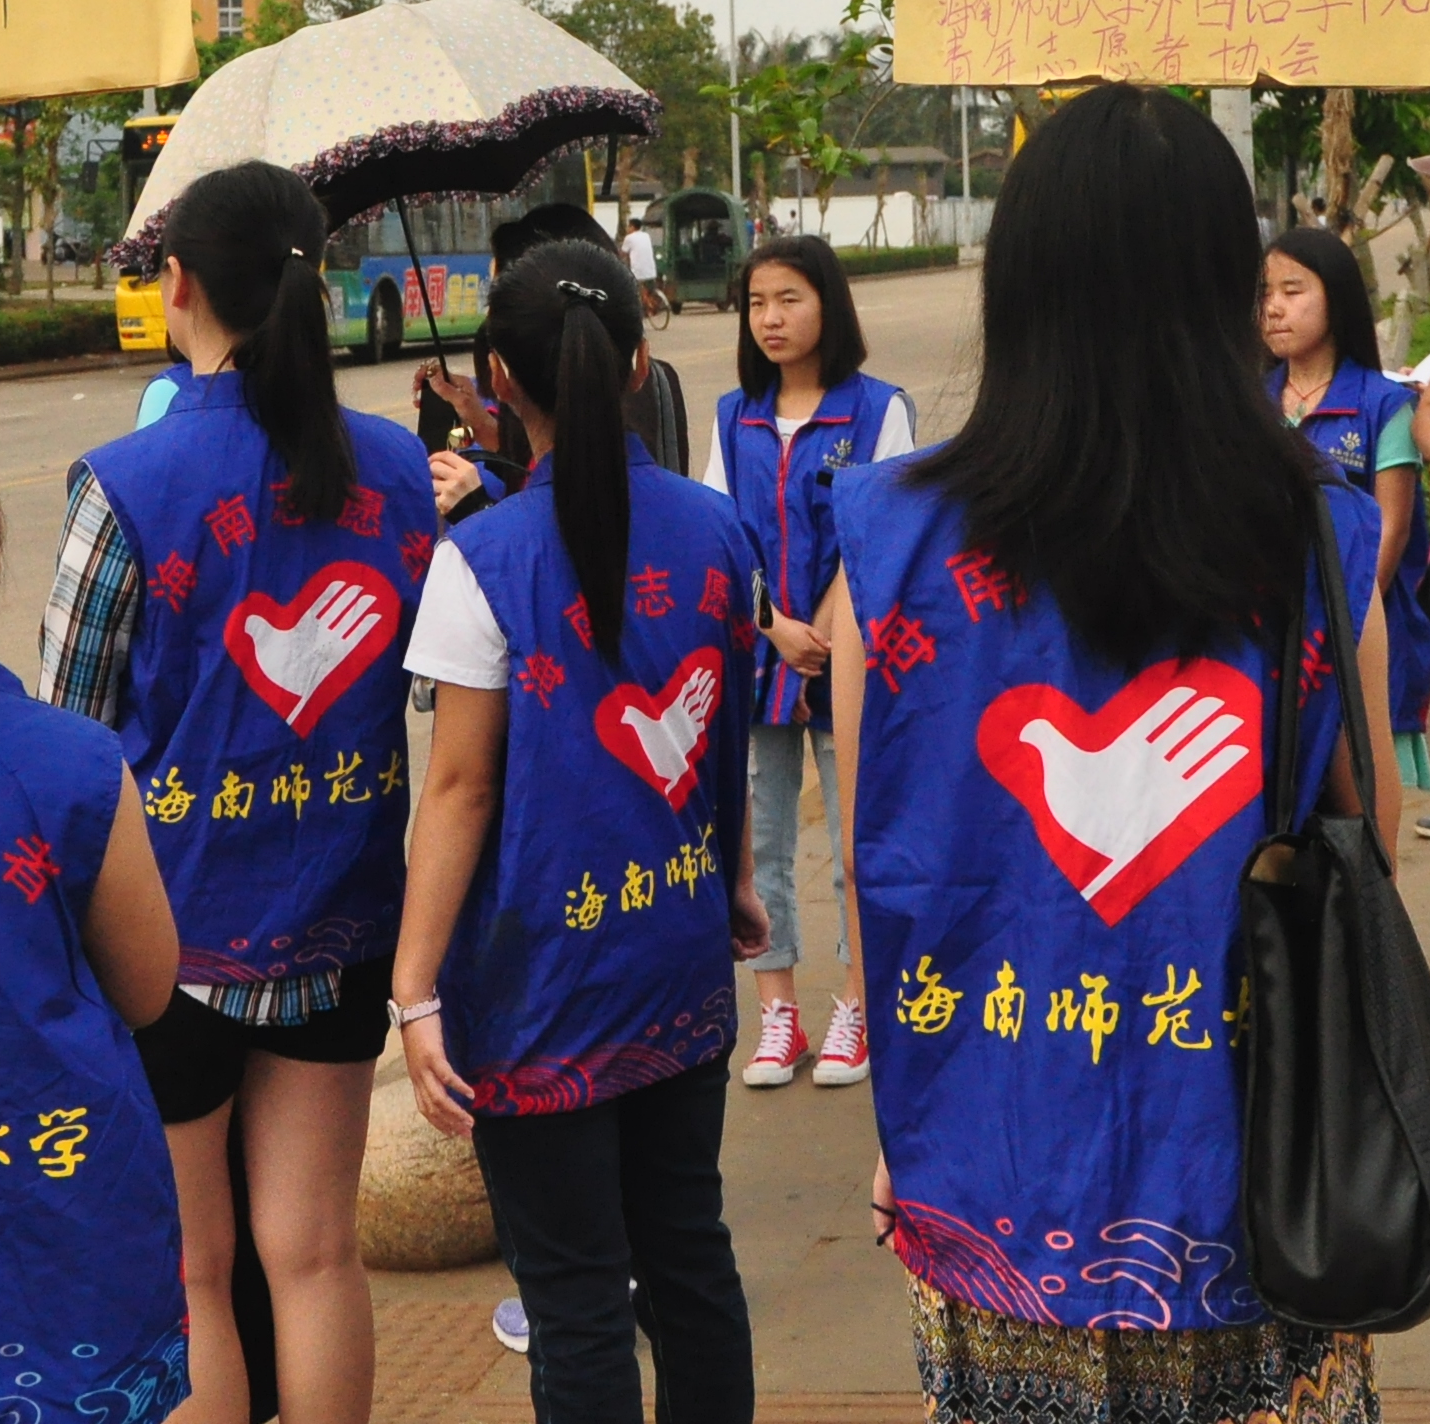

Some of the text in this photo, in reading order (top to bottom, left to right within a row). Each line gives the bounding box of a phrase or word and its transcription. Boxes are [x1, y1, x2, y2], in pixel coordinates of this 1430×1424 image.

[943, 24, 1320, 85] 青年志愿者协会
